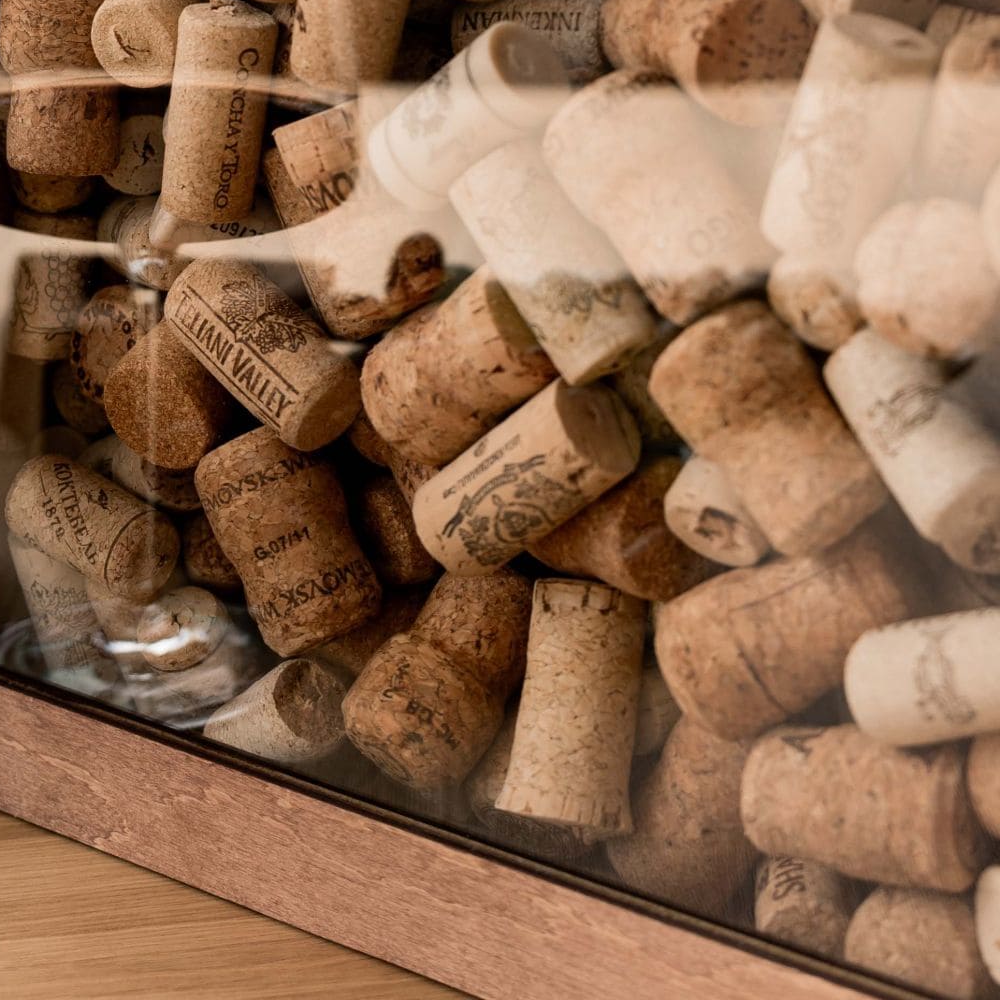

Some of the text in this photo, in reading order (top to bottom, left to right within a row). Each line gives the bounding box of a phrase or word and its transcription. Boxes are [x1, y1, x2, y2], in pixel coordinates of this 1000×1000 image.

[212, 153, 239, 211] TORO
[174, 290, 294, 419] TELIANI VALLEY
[52, 461, 99, 566] КОКТЕБЕЛЬ
